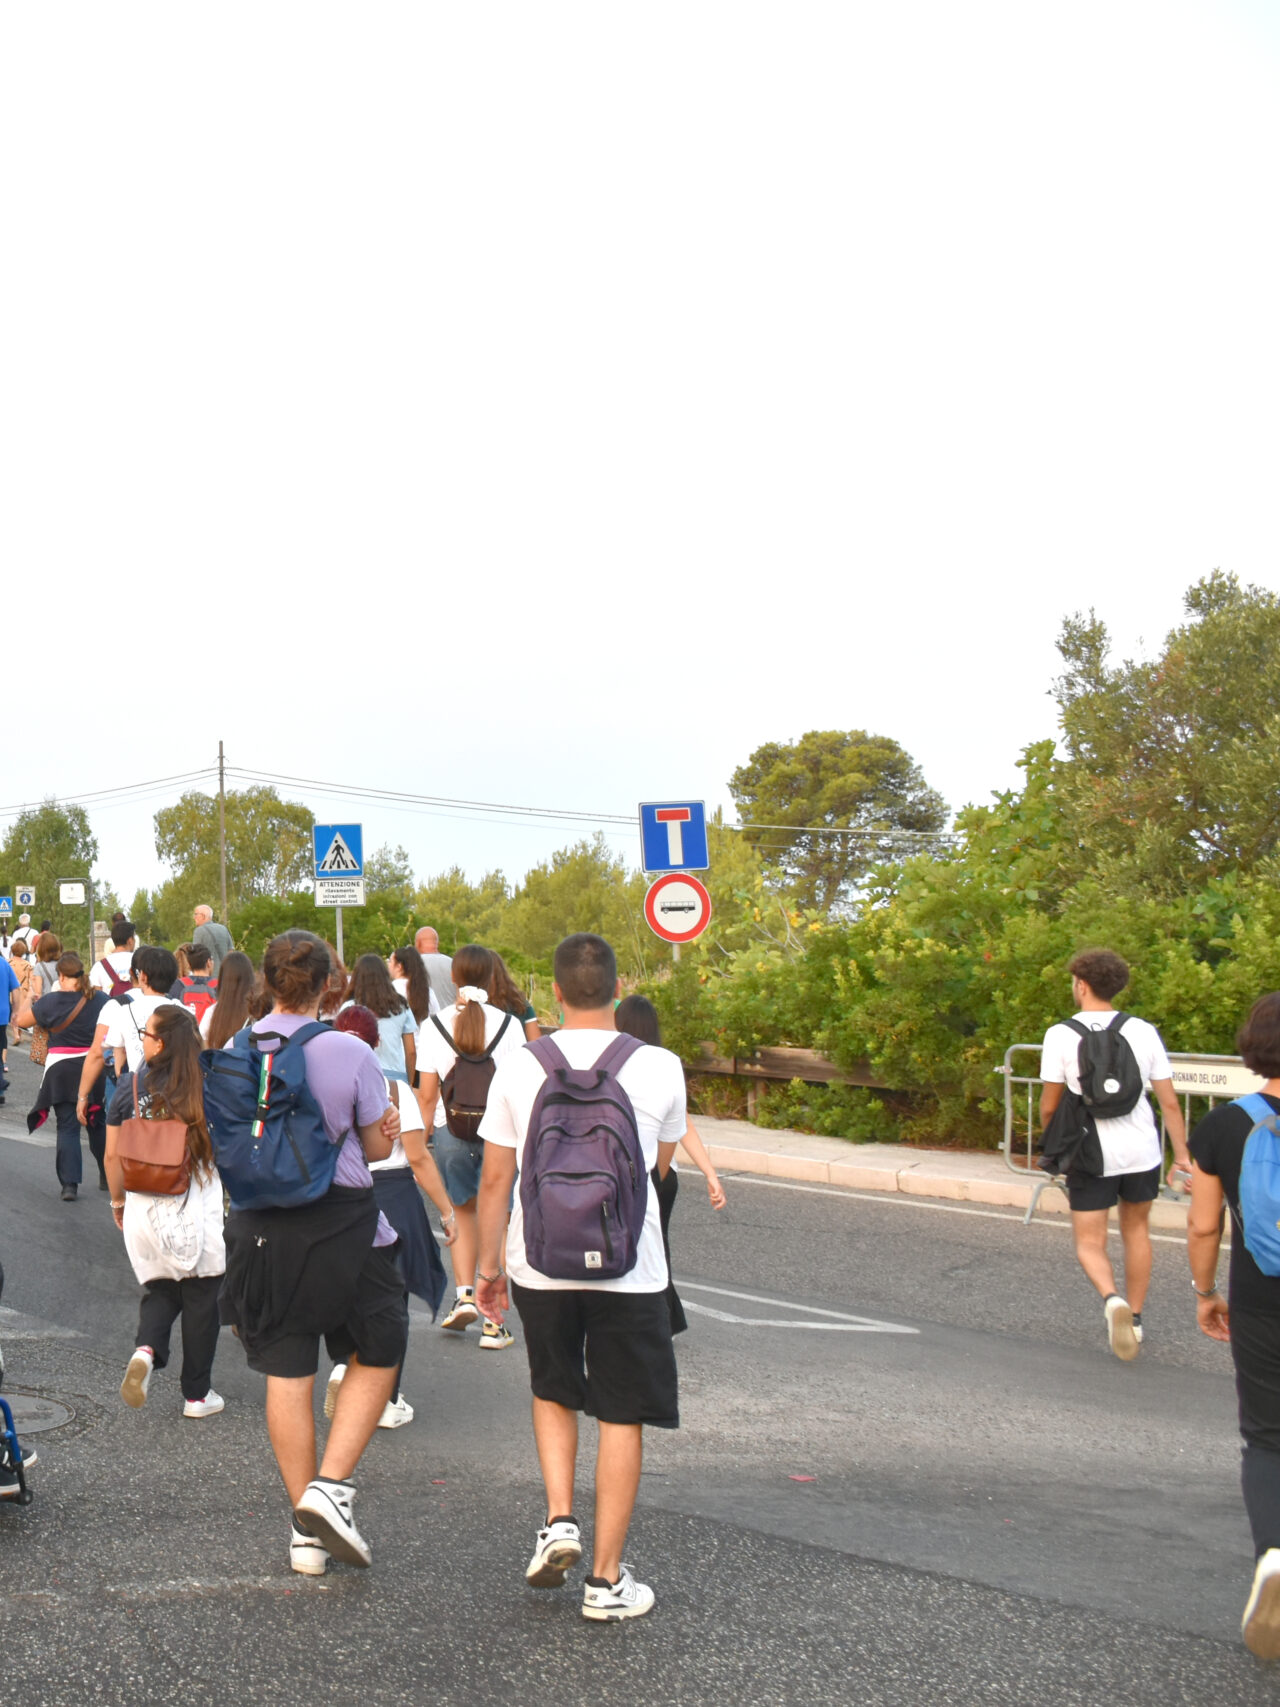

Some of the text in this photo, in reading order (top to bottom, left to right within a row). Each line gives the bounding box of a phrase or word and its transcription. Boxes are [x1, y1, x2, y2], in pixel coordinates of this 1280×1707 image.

[1171, 1071, 1227, 1085] RIGNANO DEL CAPO
